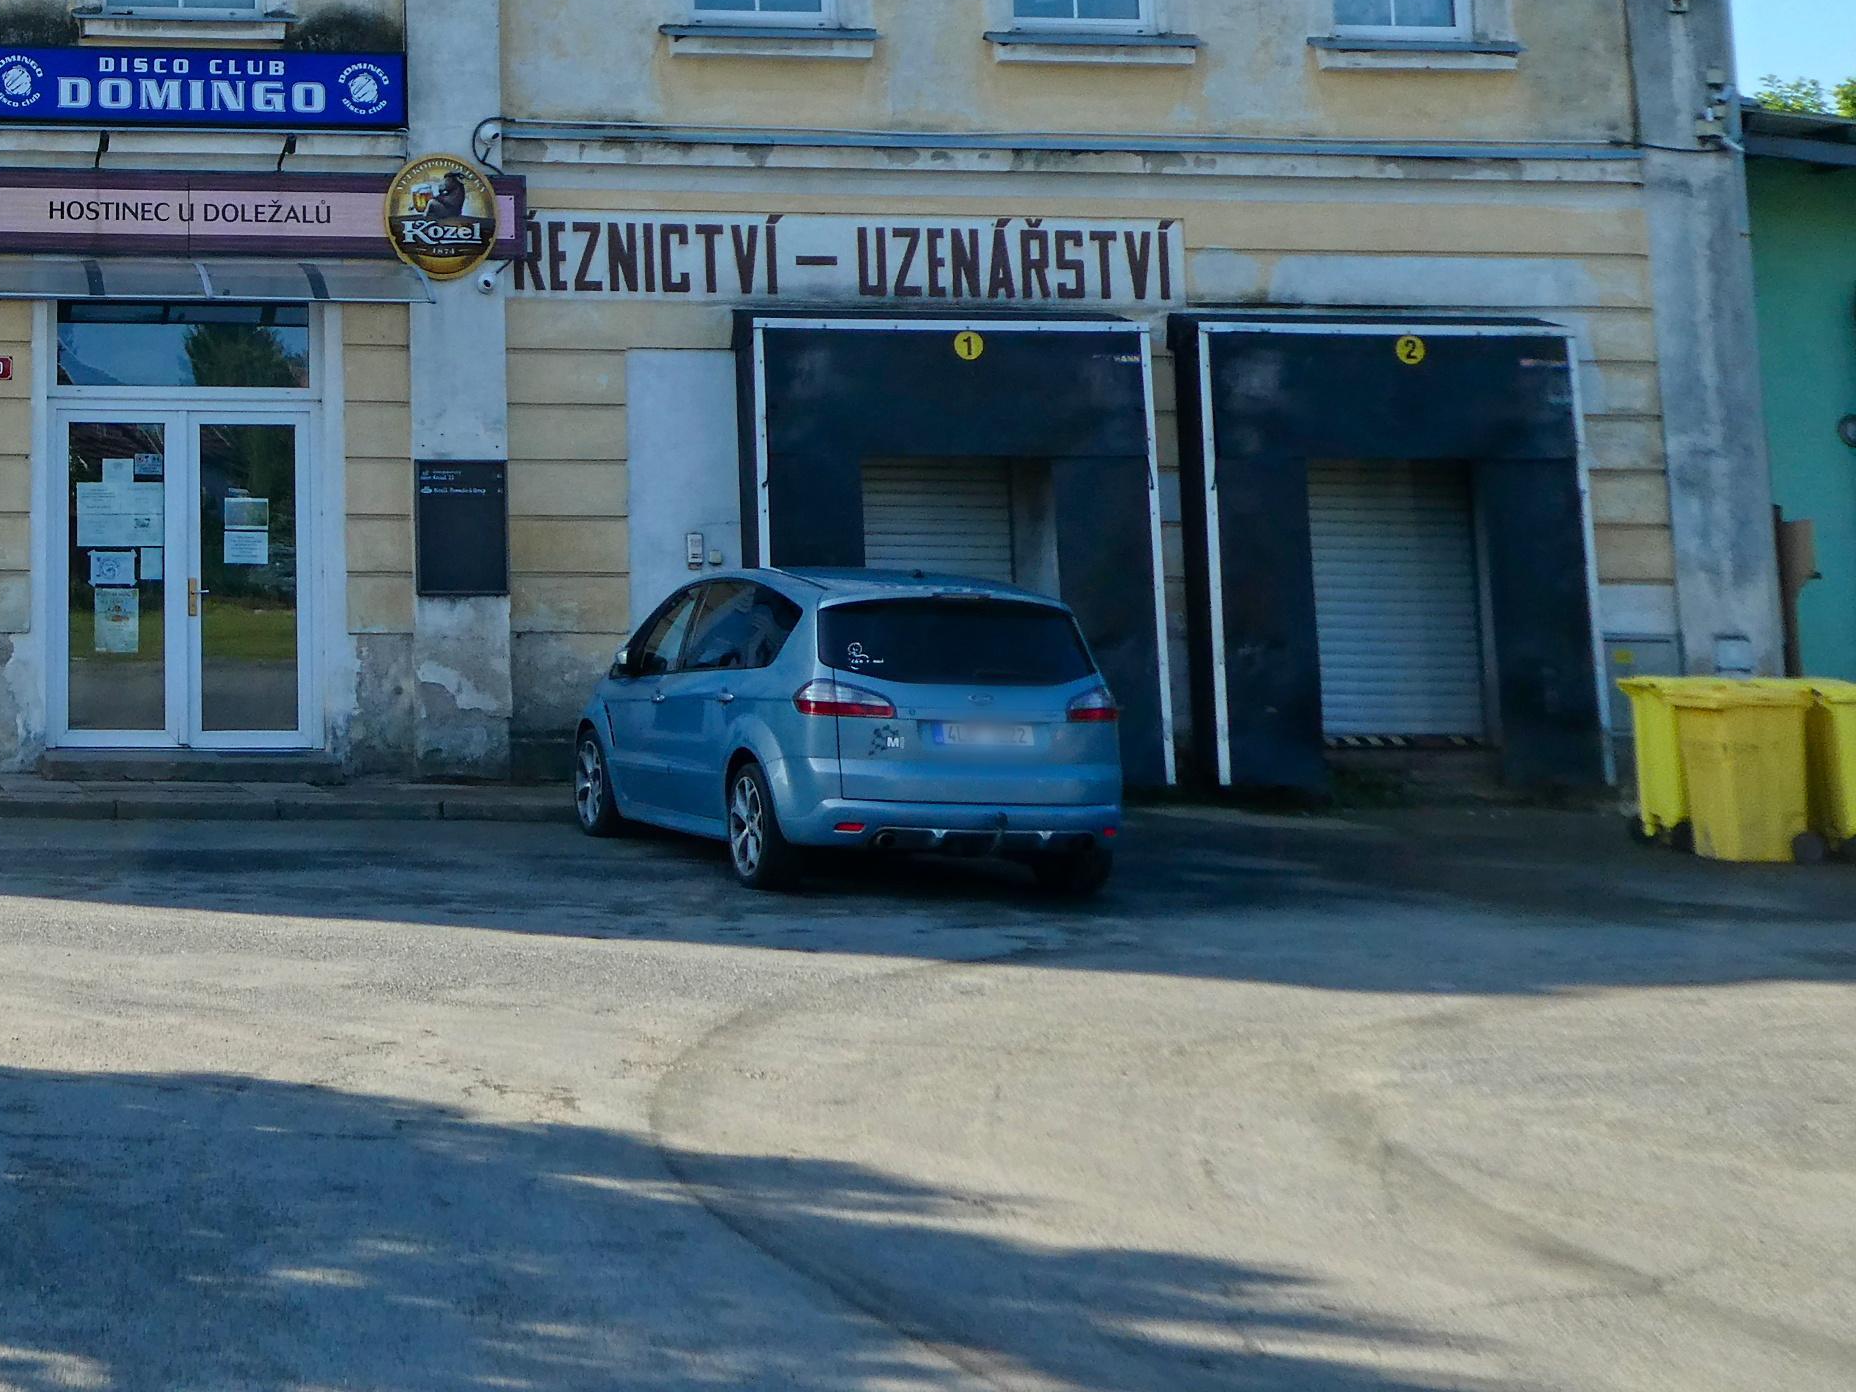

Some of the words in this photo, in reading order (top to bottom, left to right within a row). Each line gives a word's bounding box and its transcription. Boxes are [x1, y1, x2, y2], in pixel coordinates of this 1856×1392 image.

[98, 56, 190, 74] DISCO
[208, 59, 286, 76] CLUB
[337, 62, 390, 86] DOMINGO
[21, 92, 41, 107] club
[56, 76, 327, 114] DOMINGO
[48, 200, 171, 222] HOSTINEC
[178, 202, 195, 222] U
[203, 199, 331, 224] DOLEŽALŮ
[400, 219, 483, 246] Kozel
[856, 218, 1176, 300] UZENÁŘSTVÍ
[963, 336, 973, 356] 1
[1405, 339, 1418, 359] 2
